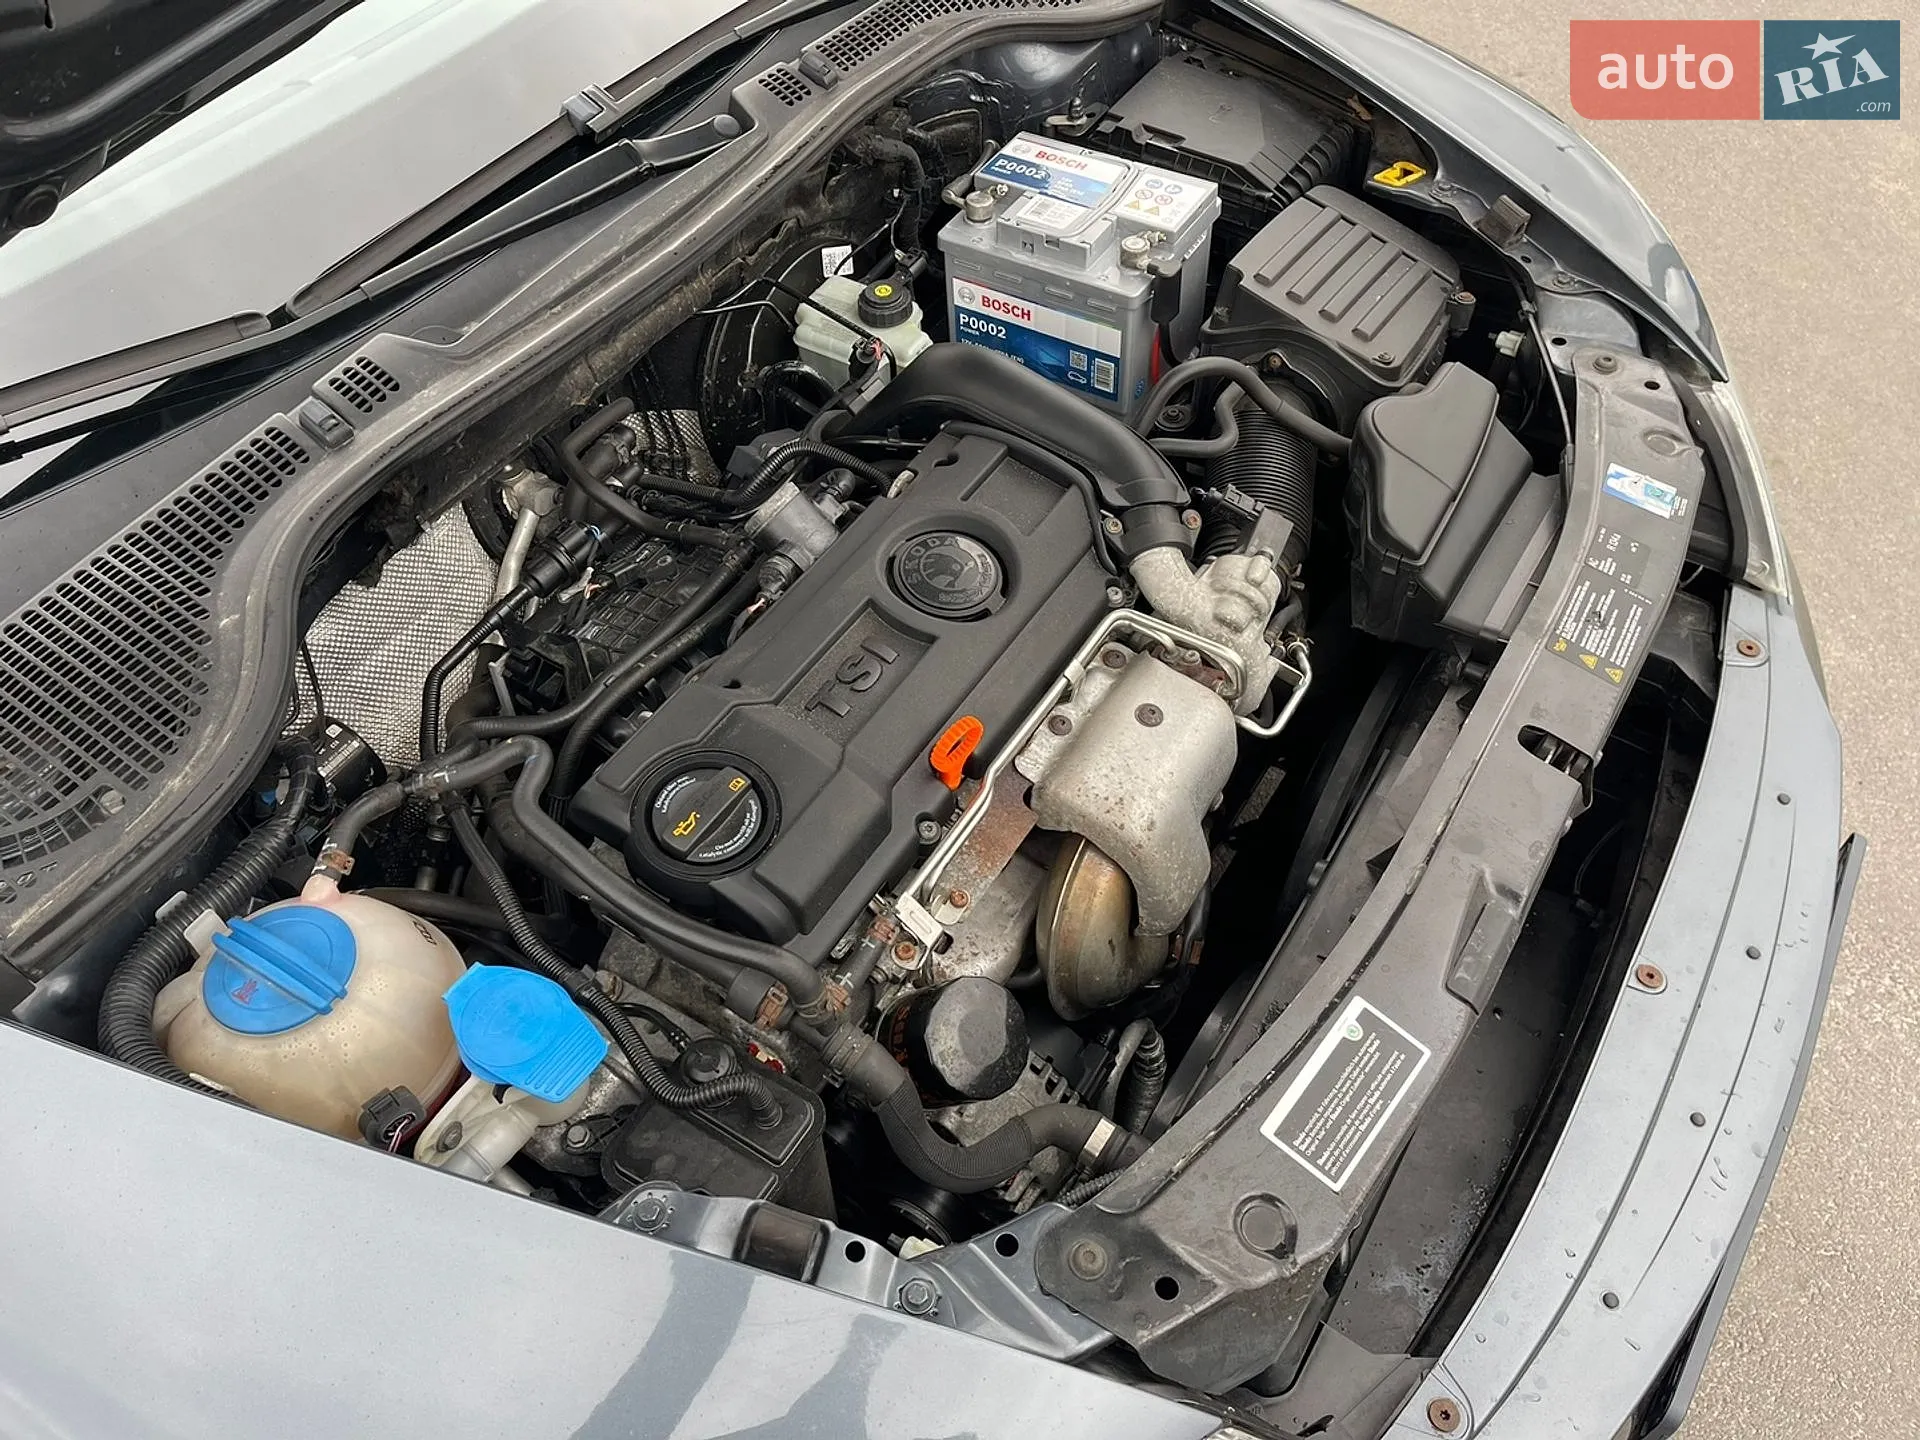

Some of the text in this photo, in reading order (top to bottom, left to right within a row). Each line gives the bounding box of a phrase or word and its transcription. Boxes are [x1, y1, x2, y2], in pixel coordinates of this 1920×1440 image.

[995, 158, 1047, 180] P0002
[1035, 150, 1088, 170] BOSCH
[981, 294, 1032, 321] BOSCH
[959, 313, 1007, 339] P0002
[960, 326, 980, 336] POWER
[804, 638, 899, 718] TSI
